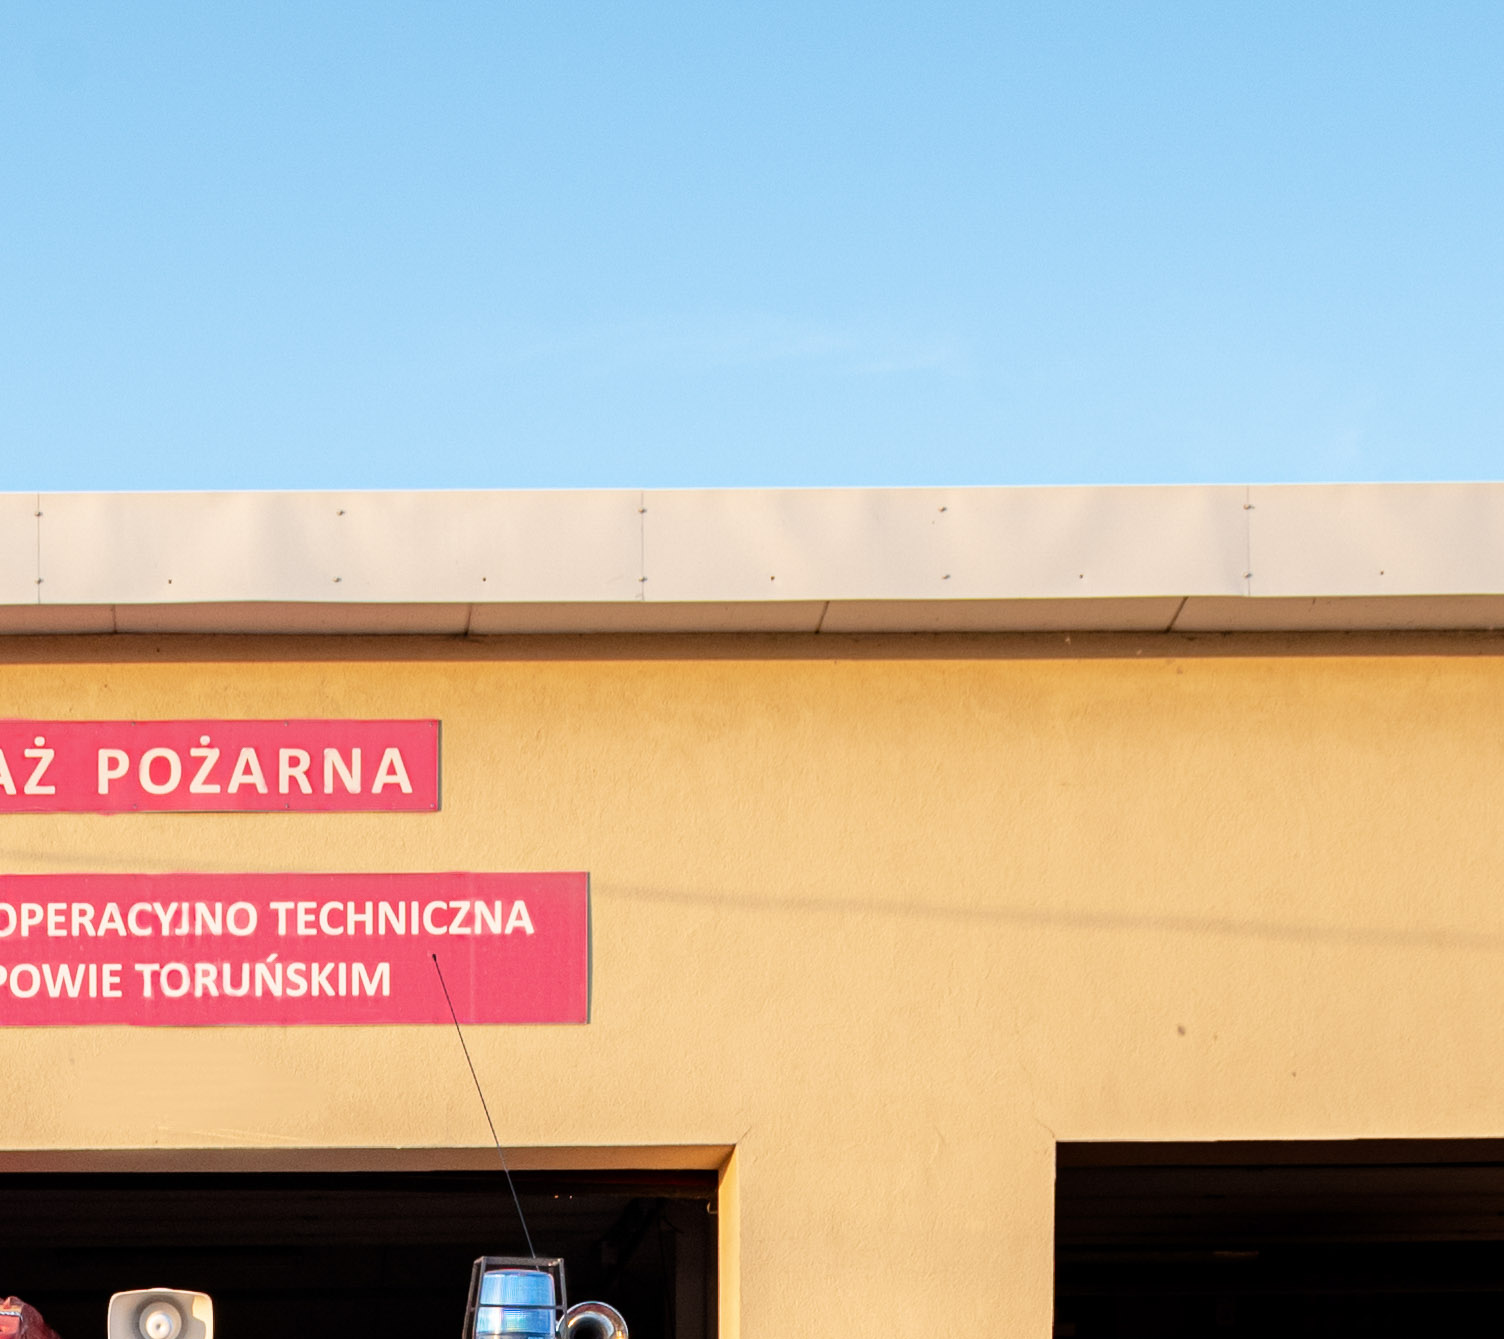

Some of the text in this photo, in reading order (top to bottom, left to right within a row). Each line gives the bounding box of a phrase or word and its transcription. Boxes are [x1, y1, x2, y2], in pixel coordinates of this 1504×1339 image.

[96, 735, 415, 796] POŻARNA
[270, 899, 536, 937] TECHNICZNA
[135, 952, 392, 999] TORUŃSKIM
